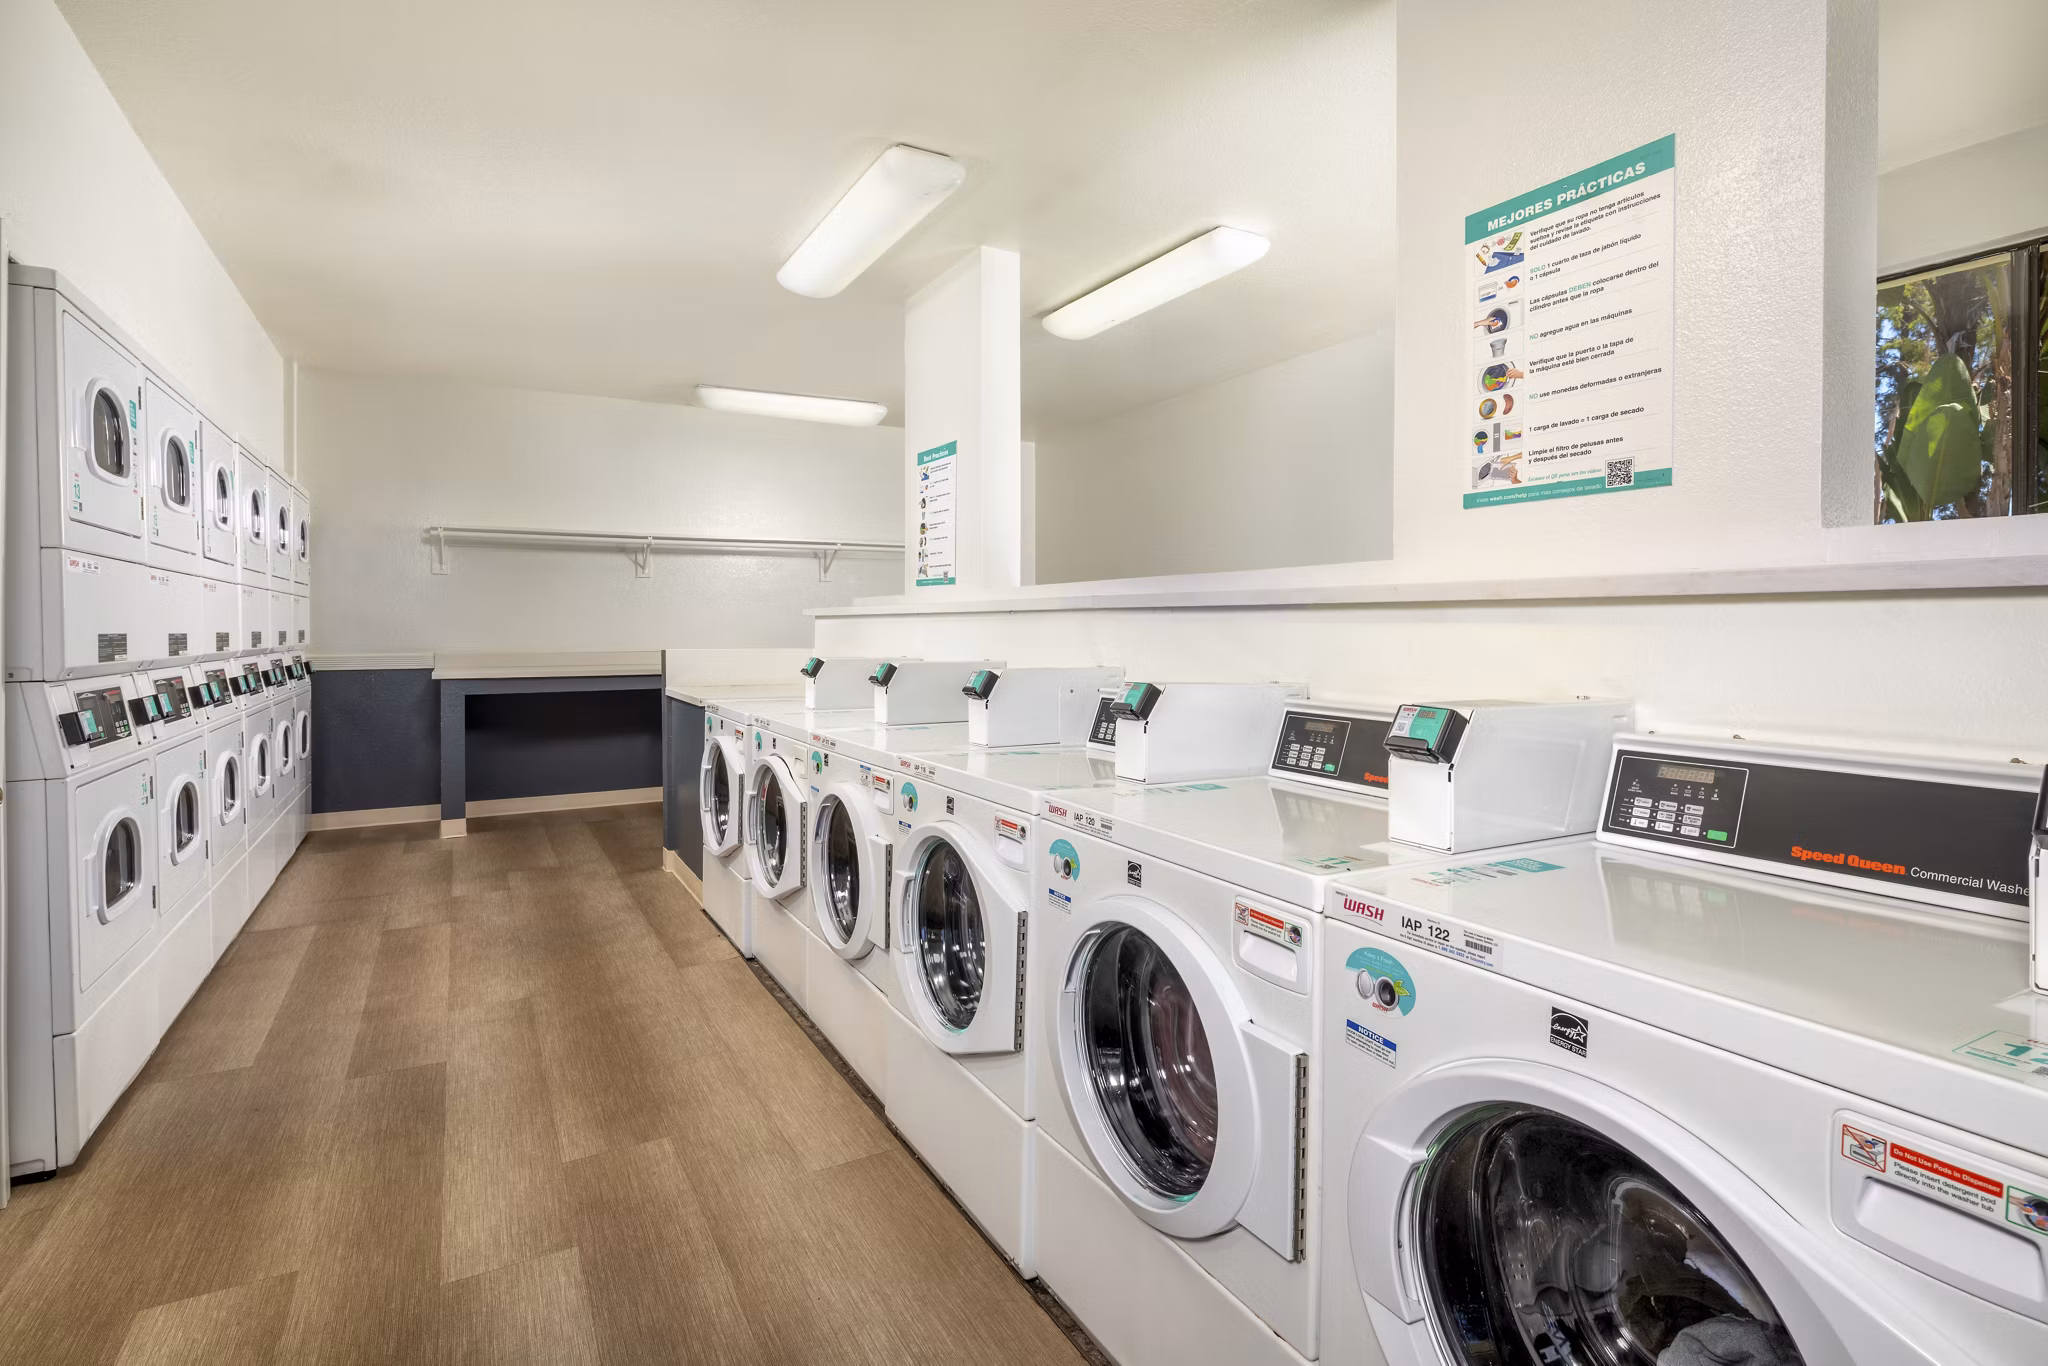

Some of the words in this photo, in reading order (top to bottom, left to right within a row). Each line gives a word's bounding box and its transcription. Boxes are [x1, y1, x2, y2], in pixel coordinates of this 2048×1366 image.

[1487, 198, 1552, 232] MEJORES
[1557, 162, 1645, 205] PRÁCTICAS
[1530, 233, 1550, 244] sueltos
[1555, 225, 1573, 234] revise
[1573, 221, 1580, 229] la
[1580, 213, 1604, 226] etiqueta
[1605, 209, 1616, 217] con
[1618, 193, 1661, 212] instrucciones
[1530, 225, 1554, 236] Verifique
[1555, 220, 1565, 228] que
[1575, 212, 1588, 220] ropa
[1598, 202, 1615, 212] tenga
[1539, 234, 1561, 249] cuidado
[1562, 231, 1570, 241] de
[1529, 264, 1546, 274] SOLO
[1551, 257, 1570, 267] cuarto
[1579, 250, 1591, 258] taza
[1592, 246, 1601, 254] de
[1600, 240, 1618, 252] jabón
[1539, 267, 1560, 278] cápsula
[1541, 288, 1568, 302] cápsulas
[1568, 280, 1591, 295] DEBEN
[1592, 273, 1623, 286] colocarse
[1625, 266, 1647, 276] dentro
[1648, 261, 1659, 269] del
[1529, 302, 1551, 312] cilindro
[1552, 295, 1568, 307] antes
[1569, 293, 1581, 301] que
[1590, 286, 1604, 294] ropa
[1539, 326, 1563, 337] agregue
[1563, 323, 1579, 331] agua
[1600, 308, 1632, 321] máquinas
[1529, 357, 1554, 366] Verifique
[1575, 347, 1595, 357] puerta
[1536, 361, 1560, 372] máquina
[1576, 355, 1589, 364] bien
[1590, 350, 1614, 359] cerrada
[1551, 384, 1578, 395] monedas
[1579, 377, 1616, 390] deformadas
[1624, 367, 1662, 379] extranjeras
[1550, 421, 1558, 429] de
[1559, 418, 1579, 426] lavado
[1591, 413, 1609, 421] carga
[1620, 407, 1644, 415] secado
[1569, 449, 1592, 457] secado
[1580, 440, 1604, 449] pelusas
[1605, 436, 1623, 444] antes
[1048, 804, 1067, 817] WASH
[1074, 813, 1083, 822] IAP
[1085, 816, 1095, 826] 120
[1791, 845, 1845, 865] Speed
[1847, 854, 1905, 875] Queen
[1910, 867, 1983, 889] Commercial
[1987, 880, 2030, 897] Washe
[1343, 898, 1384, 921] WASH
[1401, 916, 1422, 932] IAP
[1427, 925, 1450, 942] 122
[1358, 1026, 1384, 1045] NOTICE
[1550, 1037, 1571, 1049] ENERGY
[1893, 1148, 1903, 1157] Do
[1904, 1152, 1917, 1162] Not
[1918, 1157, 1932, 1167] Use
[1934, 1163, 1952, 1175] Pods
[1953, 1170, 1960, 1178] in
[1962, 1174, 2000, 1193] Dispenser
[1894, 1162, 1918, 1176] Please
[1920, 1170, 1941, 1185] insert
[1942, 1178, 1979, 1199] detergent
[1981, 1196, 1996, 1206] pod
[1895, 1170, 1920, 1184] directly
[1922, 1180, 1935, 1190] into
[1937, 1185, 1949, 1196] the
[1951, 1192, 1979, 1207] washer
[1981, 1203, 1994, 1213] tub
